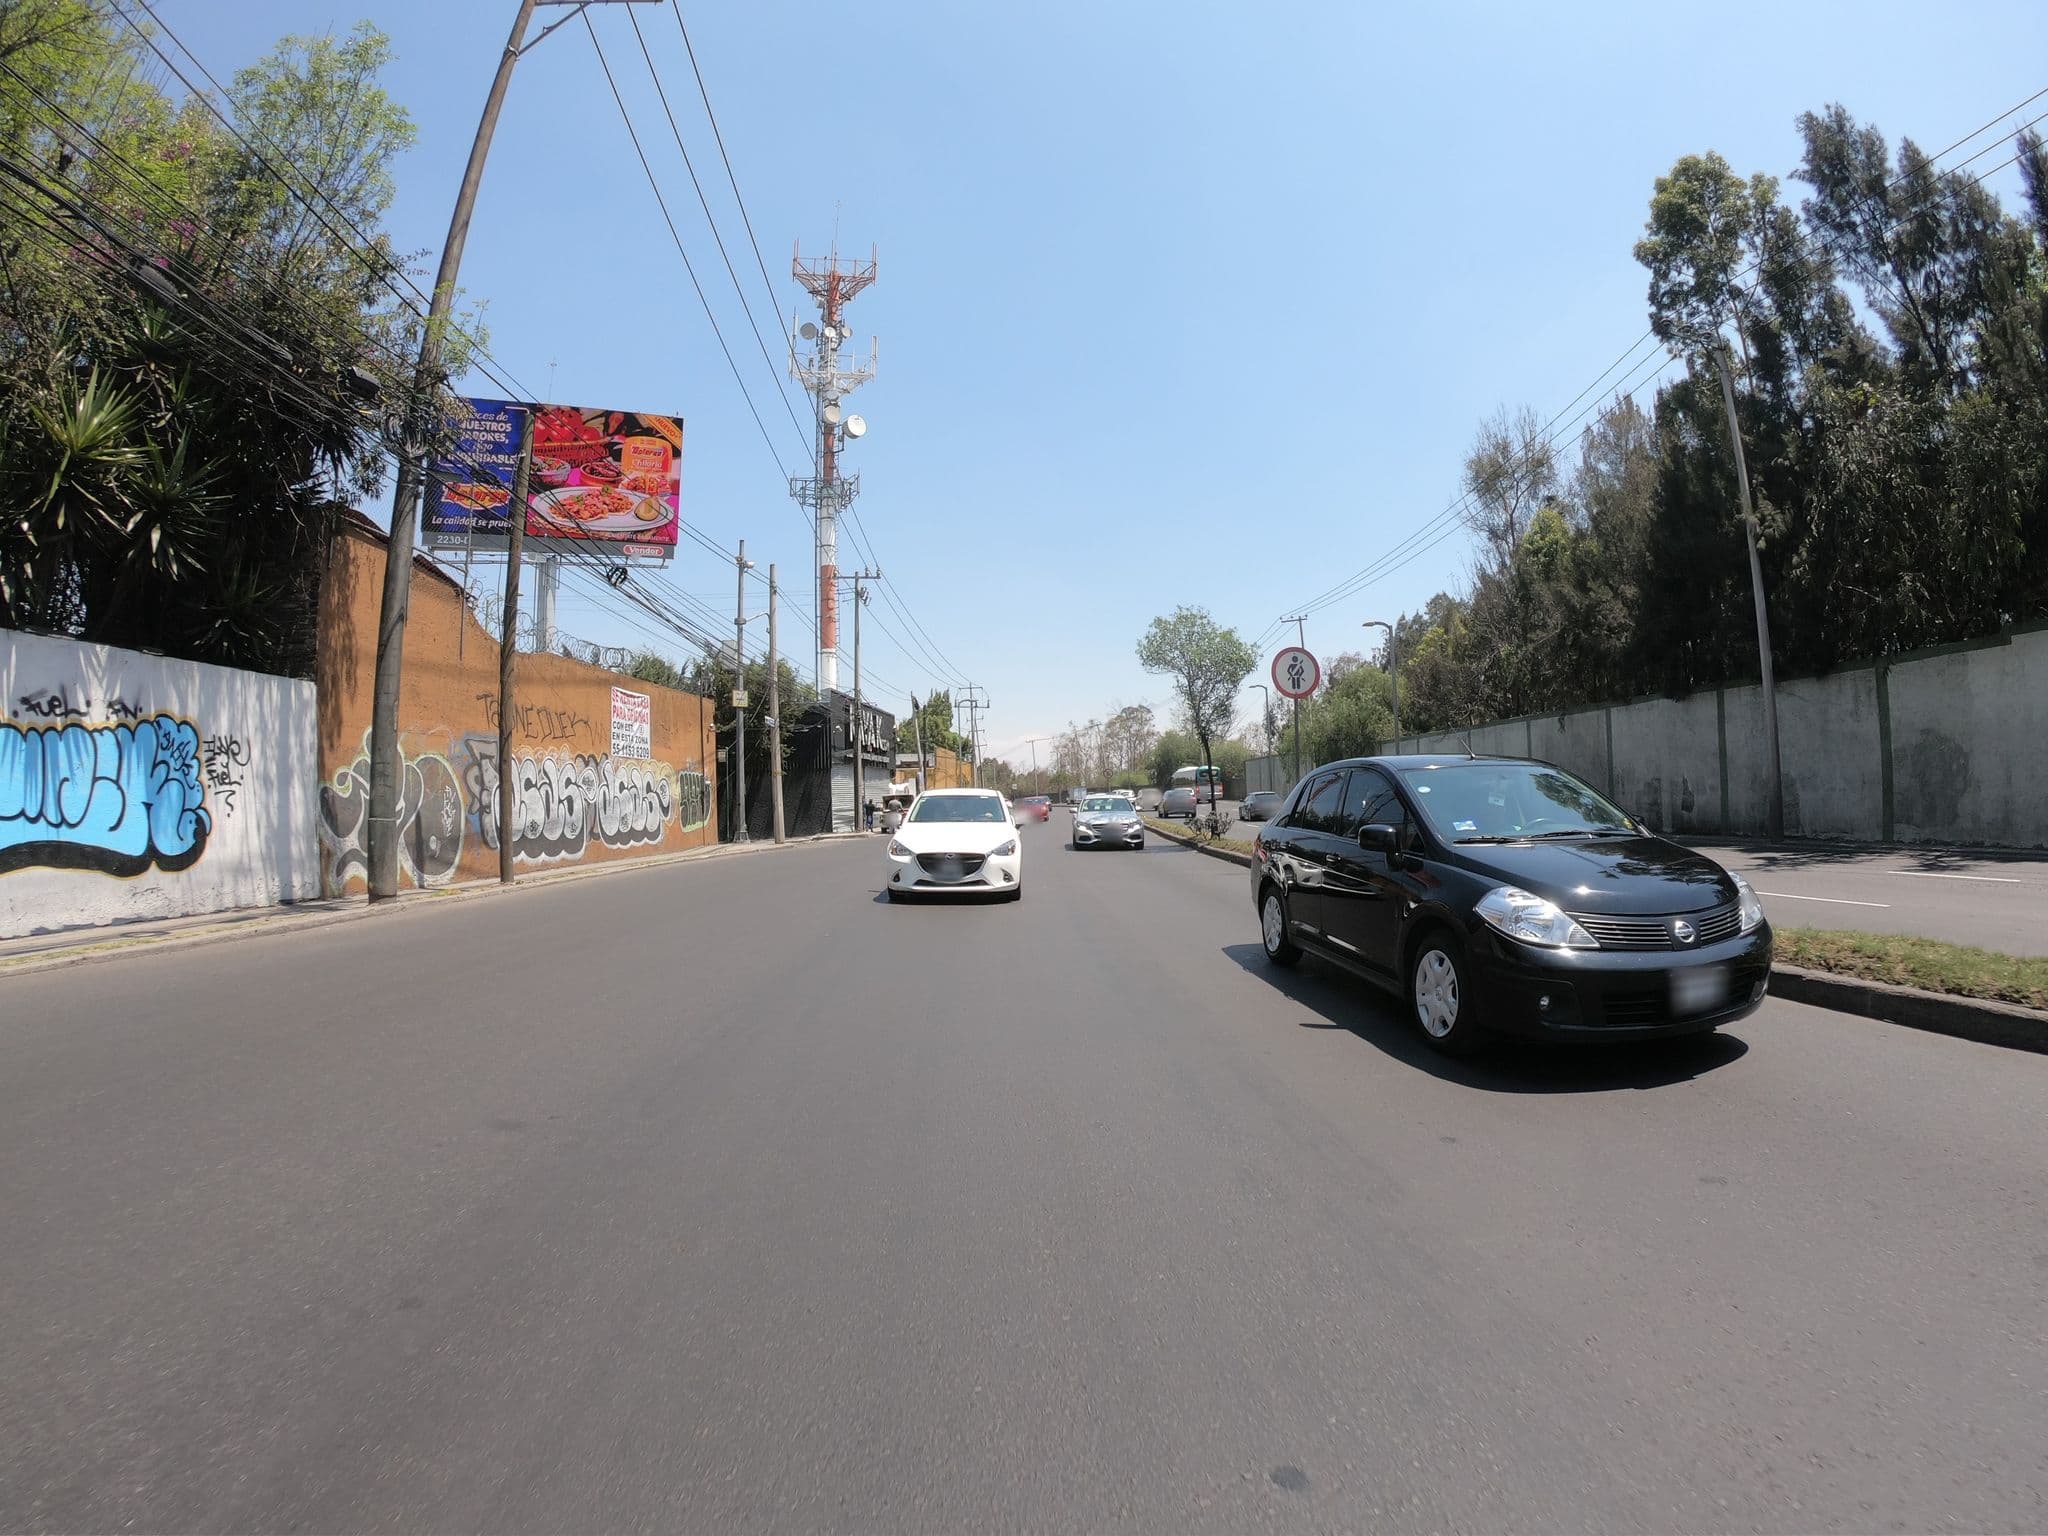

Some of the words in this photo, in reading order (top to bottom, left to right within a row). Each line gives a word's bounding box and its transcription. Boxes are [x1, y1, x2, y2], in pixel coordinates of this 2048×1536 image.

[496, 411, 509, 421] de
[432, 516, 442, 524] La
[478, 519, 487, 527] se
[629, 546, 660, 556] Vendor
[612, 732, 621, 740] EN
[621, 733, 634, 742] ESTA
[635, 735, 648, 745] ZONA
